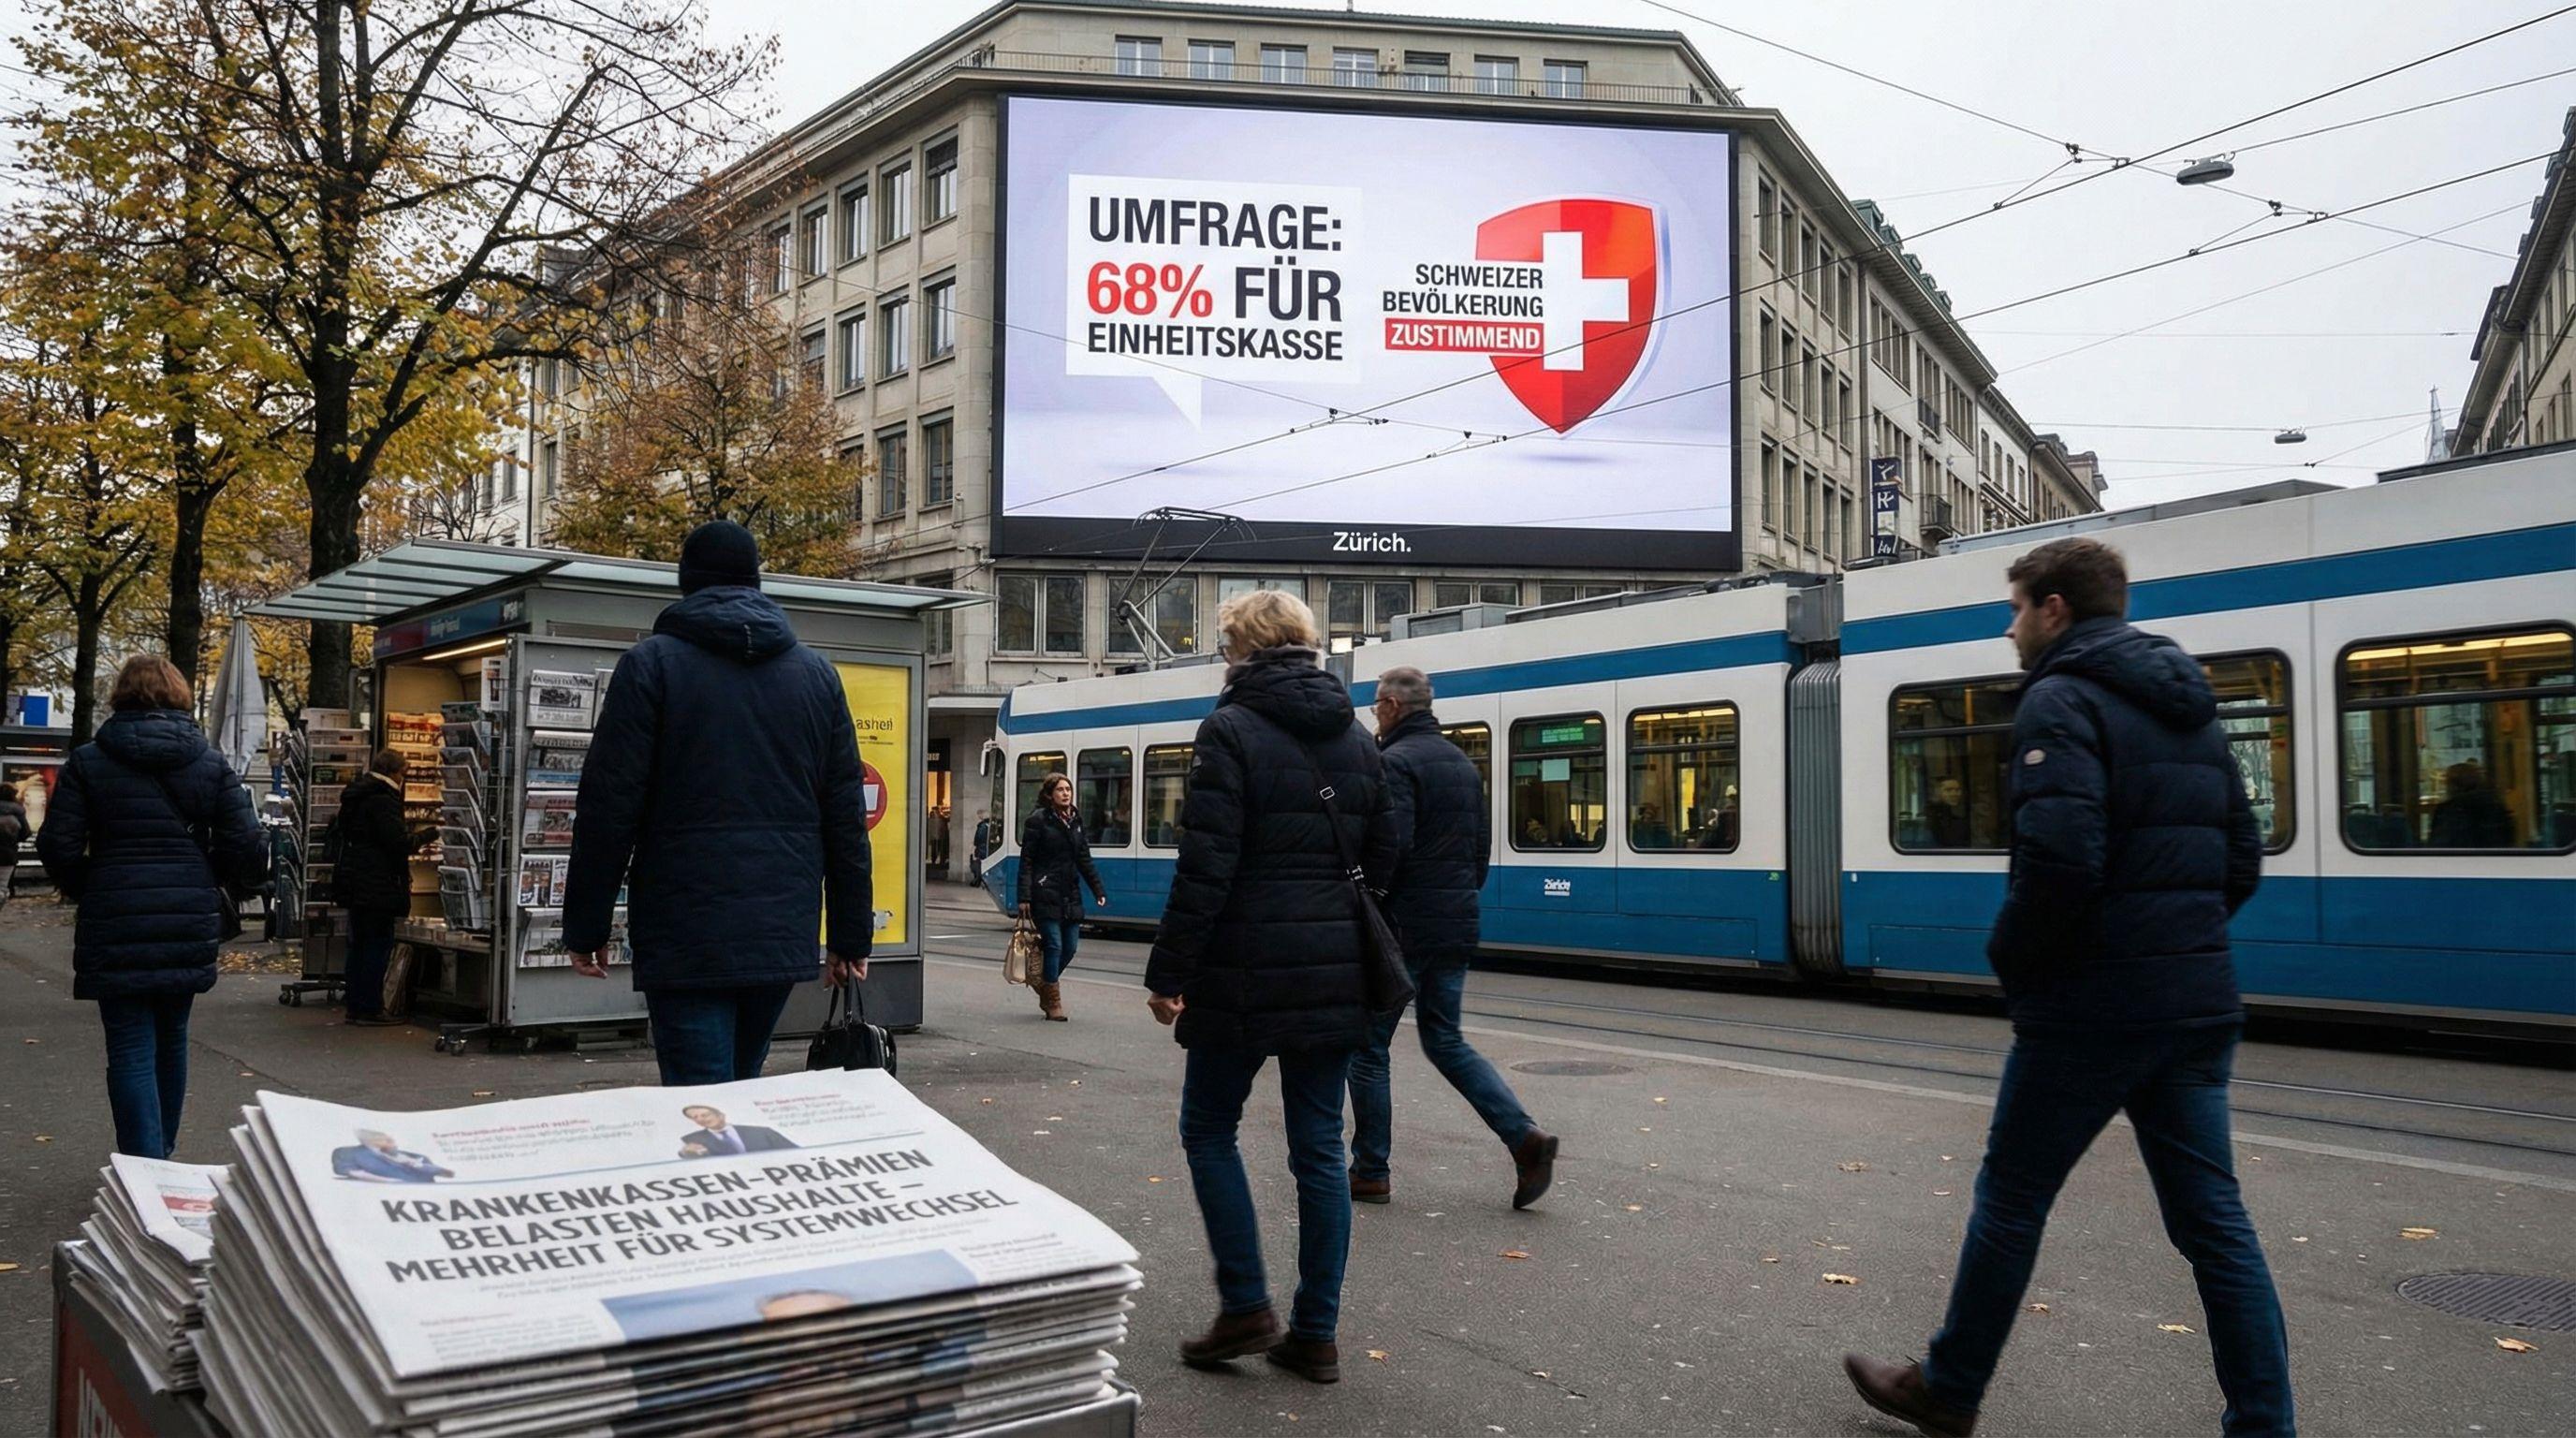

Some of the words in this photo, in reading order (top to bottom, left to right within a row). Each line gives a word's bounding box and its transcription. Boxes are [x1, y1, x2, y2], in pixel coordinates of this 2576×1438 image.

[1090, 197, 1341, 251] UMFRAGE:
[1088, 261, 1213, 318] 68%
[1235, 256, 1341, 322] FÜR
[1415, 264, 1543, 289] SCHWEIZER
[1383, 288, 1544, 318] BEVÖLKERUNG
[1088, 323, 1342, 361] EINHEITSKASSE
[1391, 323, 1540, 350] ZUSTIMMEND
[1333, 531, 1411, 552] Zürich.
[382, 1150, 933, 1223] KRANKENKASSEN-PRÄMIEN
[386, 1243, 607, 1284] MEHRHEIT
[616, 1232, 700, 1260] FÜR
[703, 1189, 1018, 1249] SYSTEMWECHSEL
[439, 1209, 663, 1251] BELASTEN
[668, 1181, 895, 1225] HAUSHALTE
